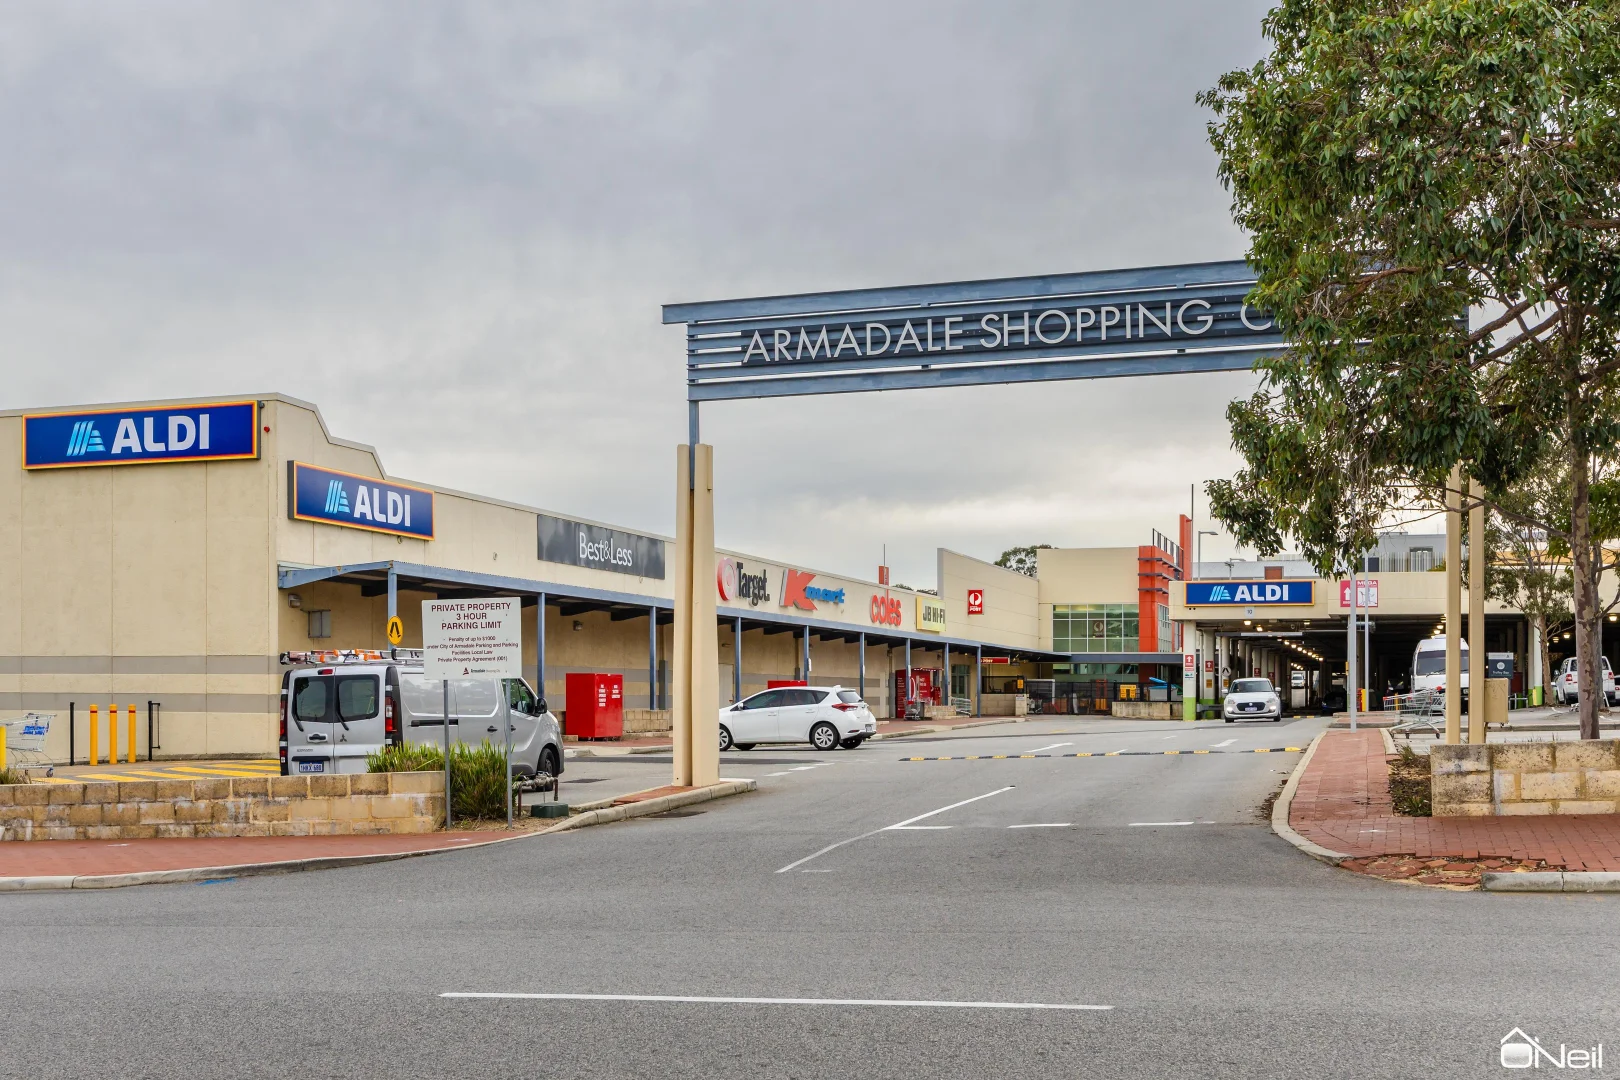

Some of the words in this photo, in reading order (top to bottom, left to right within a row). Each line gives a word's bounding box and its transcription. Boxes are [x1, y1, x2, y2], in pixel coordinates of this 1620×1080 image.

[742, 316, 964, 363] ARMADALE
[979, 299, 1213, 349] SHOPPING
[110, 414, 210, 454] ALDI
[353, 484, 411, 527] ALDI
[579, 532, 633, 568] Best&Less
[1234, 584, 1289, 602] ALDI
[431, 604, 465, 612] PRIVATE
[467, 603, 511, 611] PROPERTY
[456, 613, 461, 621] 3
[463, 612, 487, 620] HOUR
[870, 589, 902, 626] coles
[923, 606, 931, 621] JB
[932, 608, 945, 624] HI-FI
[441, 622, 478, 630] PARKING
[480, 621, 502, 629] LIMIT
